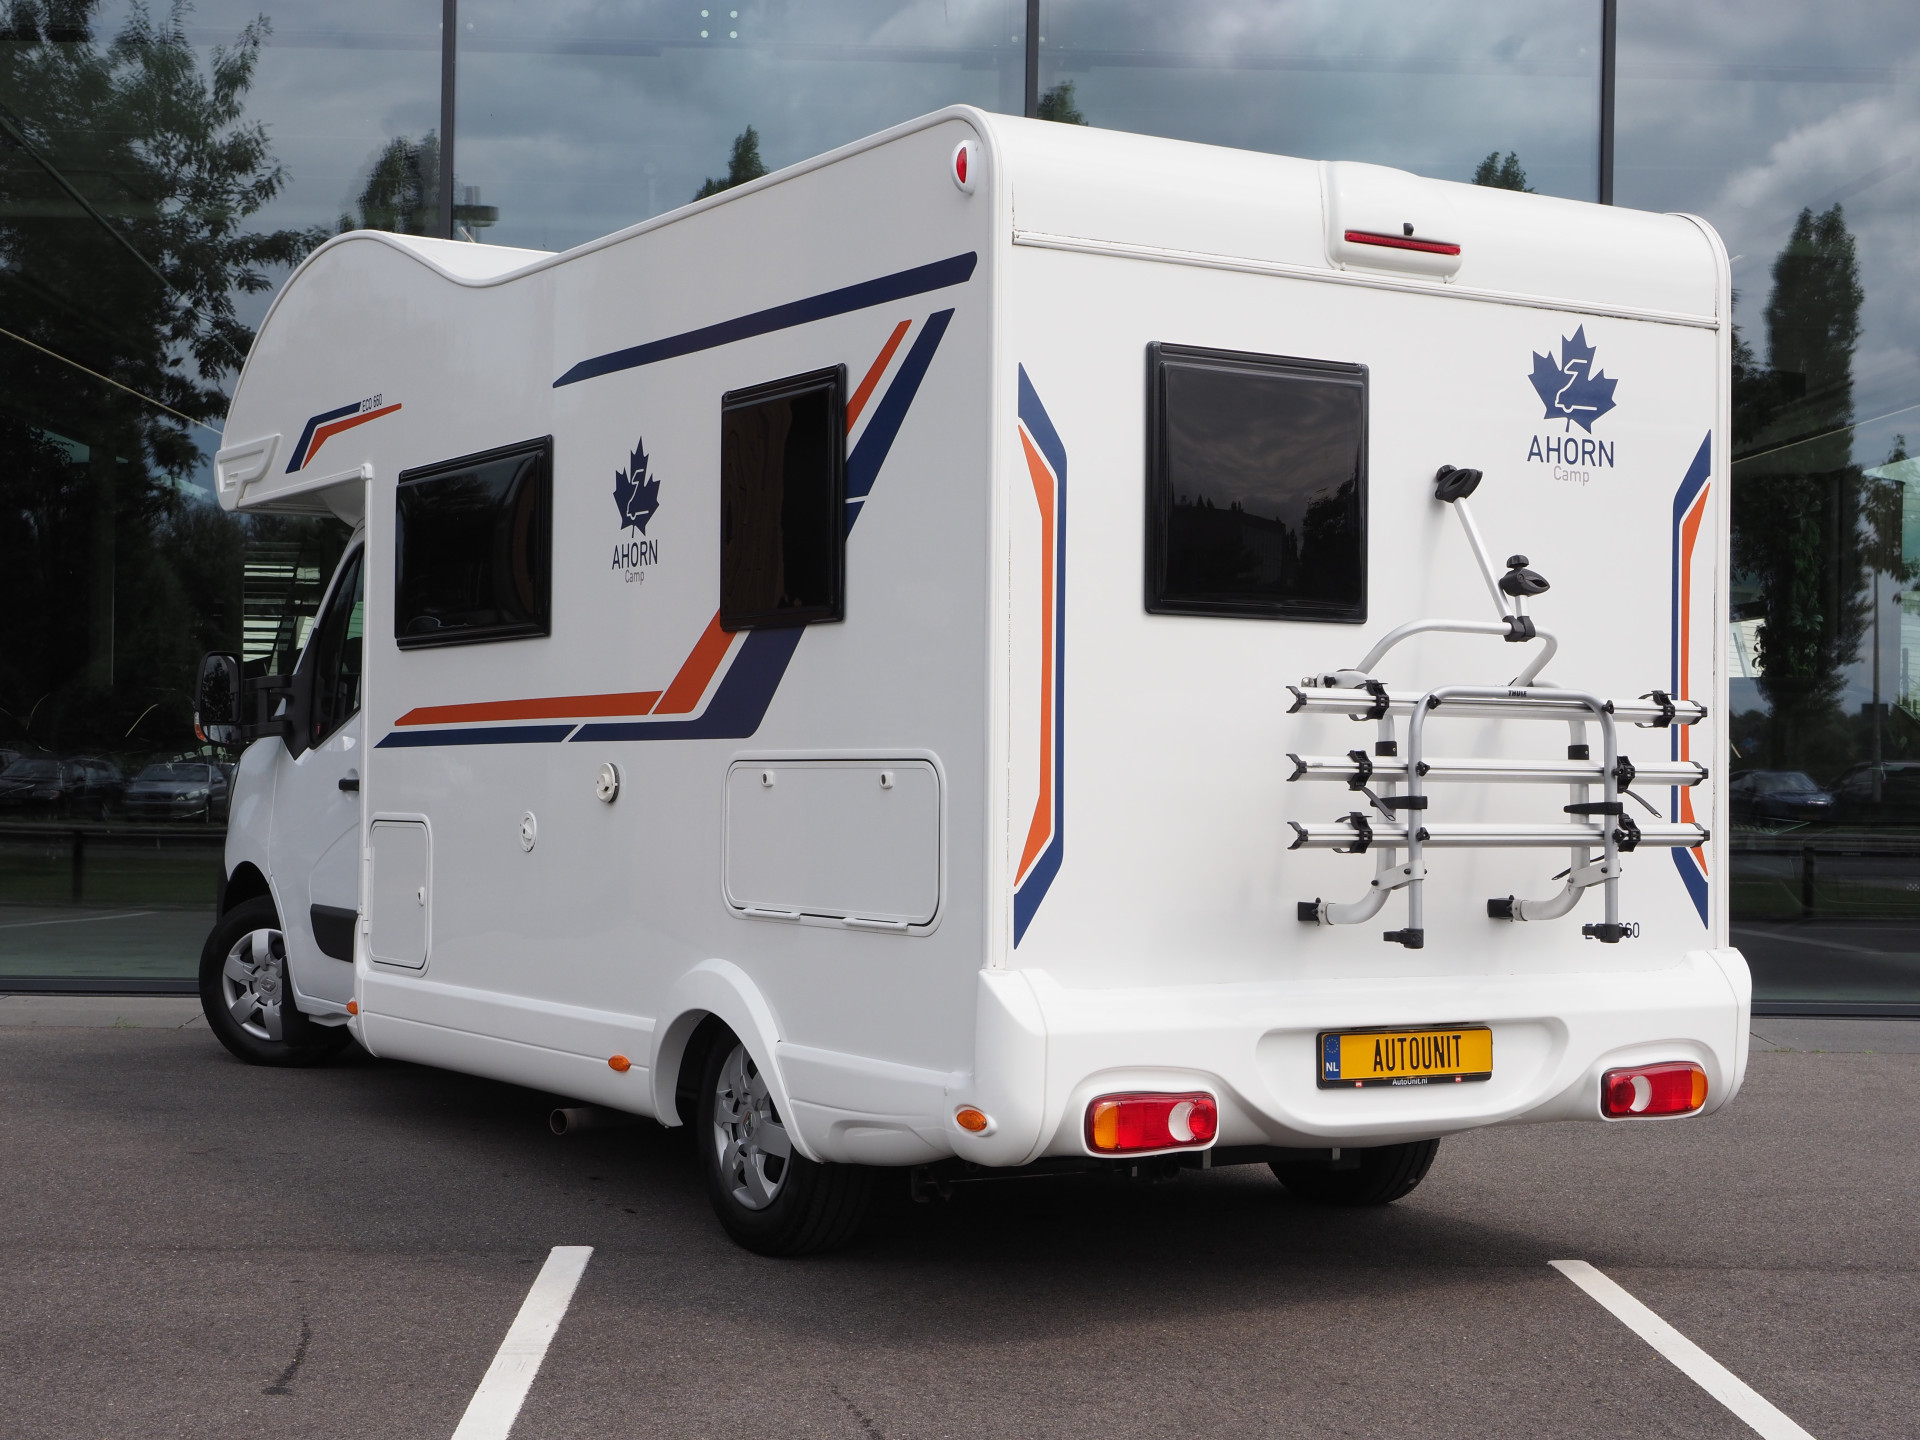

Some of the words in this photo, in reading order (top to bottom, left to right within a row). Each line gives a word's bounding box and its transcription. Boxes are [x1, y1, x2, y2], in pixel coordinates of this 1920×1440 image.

[362, 397, 373, 412] ECO
[1526, 434, 1614, 468] AHORN
[1553, 465, 1590, 487] Camp
[611, 538, 658, 570] AHORN
[624, 569, 645, 586] Camp
[1618, 921, 1640, 939] 60
[1373, 1034, 1462, 1072] AUTOUNIT
[1325, 1061, 1340, 1072] NL
[1391, 1077, 1428, 1086] AutoUnit.nl
